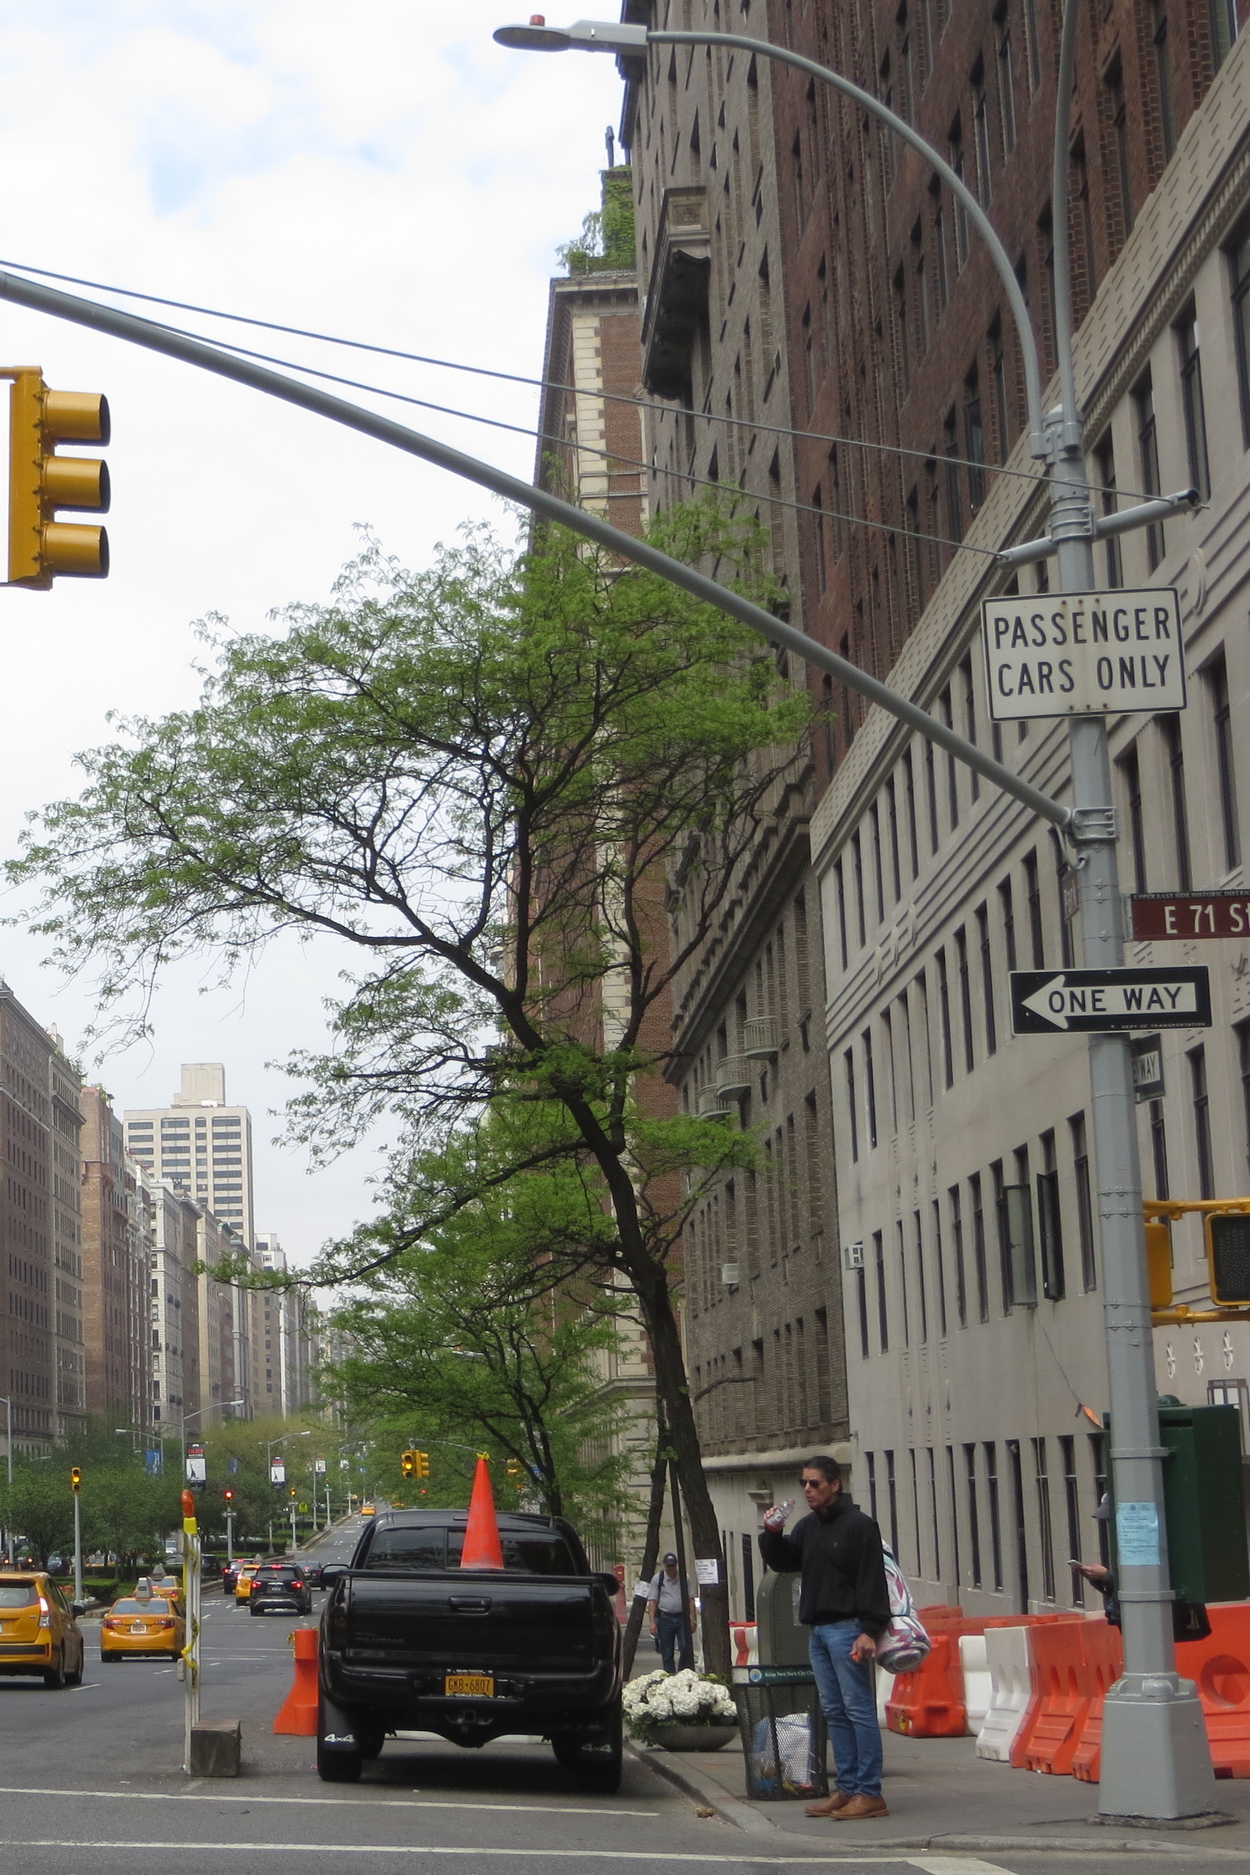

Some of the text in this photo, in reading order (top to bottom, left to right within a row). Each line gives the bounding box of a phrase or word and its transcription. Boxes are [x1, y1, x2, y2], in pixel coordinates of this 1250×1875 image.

[994, 608, 1171, 650] PASSENGER
[997, 654, 1170, 697] CARS ONLY
[1165, 906, 1178, 934] E
[1190, 904, 1215, 933] 71
[1048, 986, 1182, 1014] ONE WAY
[324, 1733, 355, 1742] 4x4
[581, 1743, 613, 1753] 4x4
